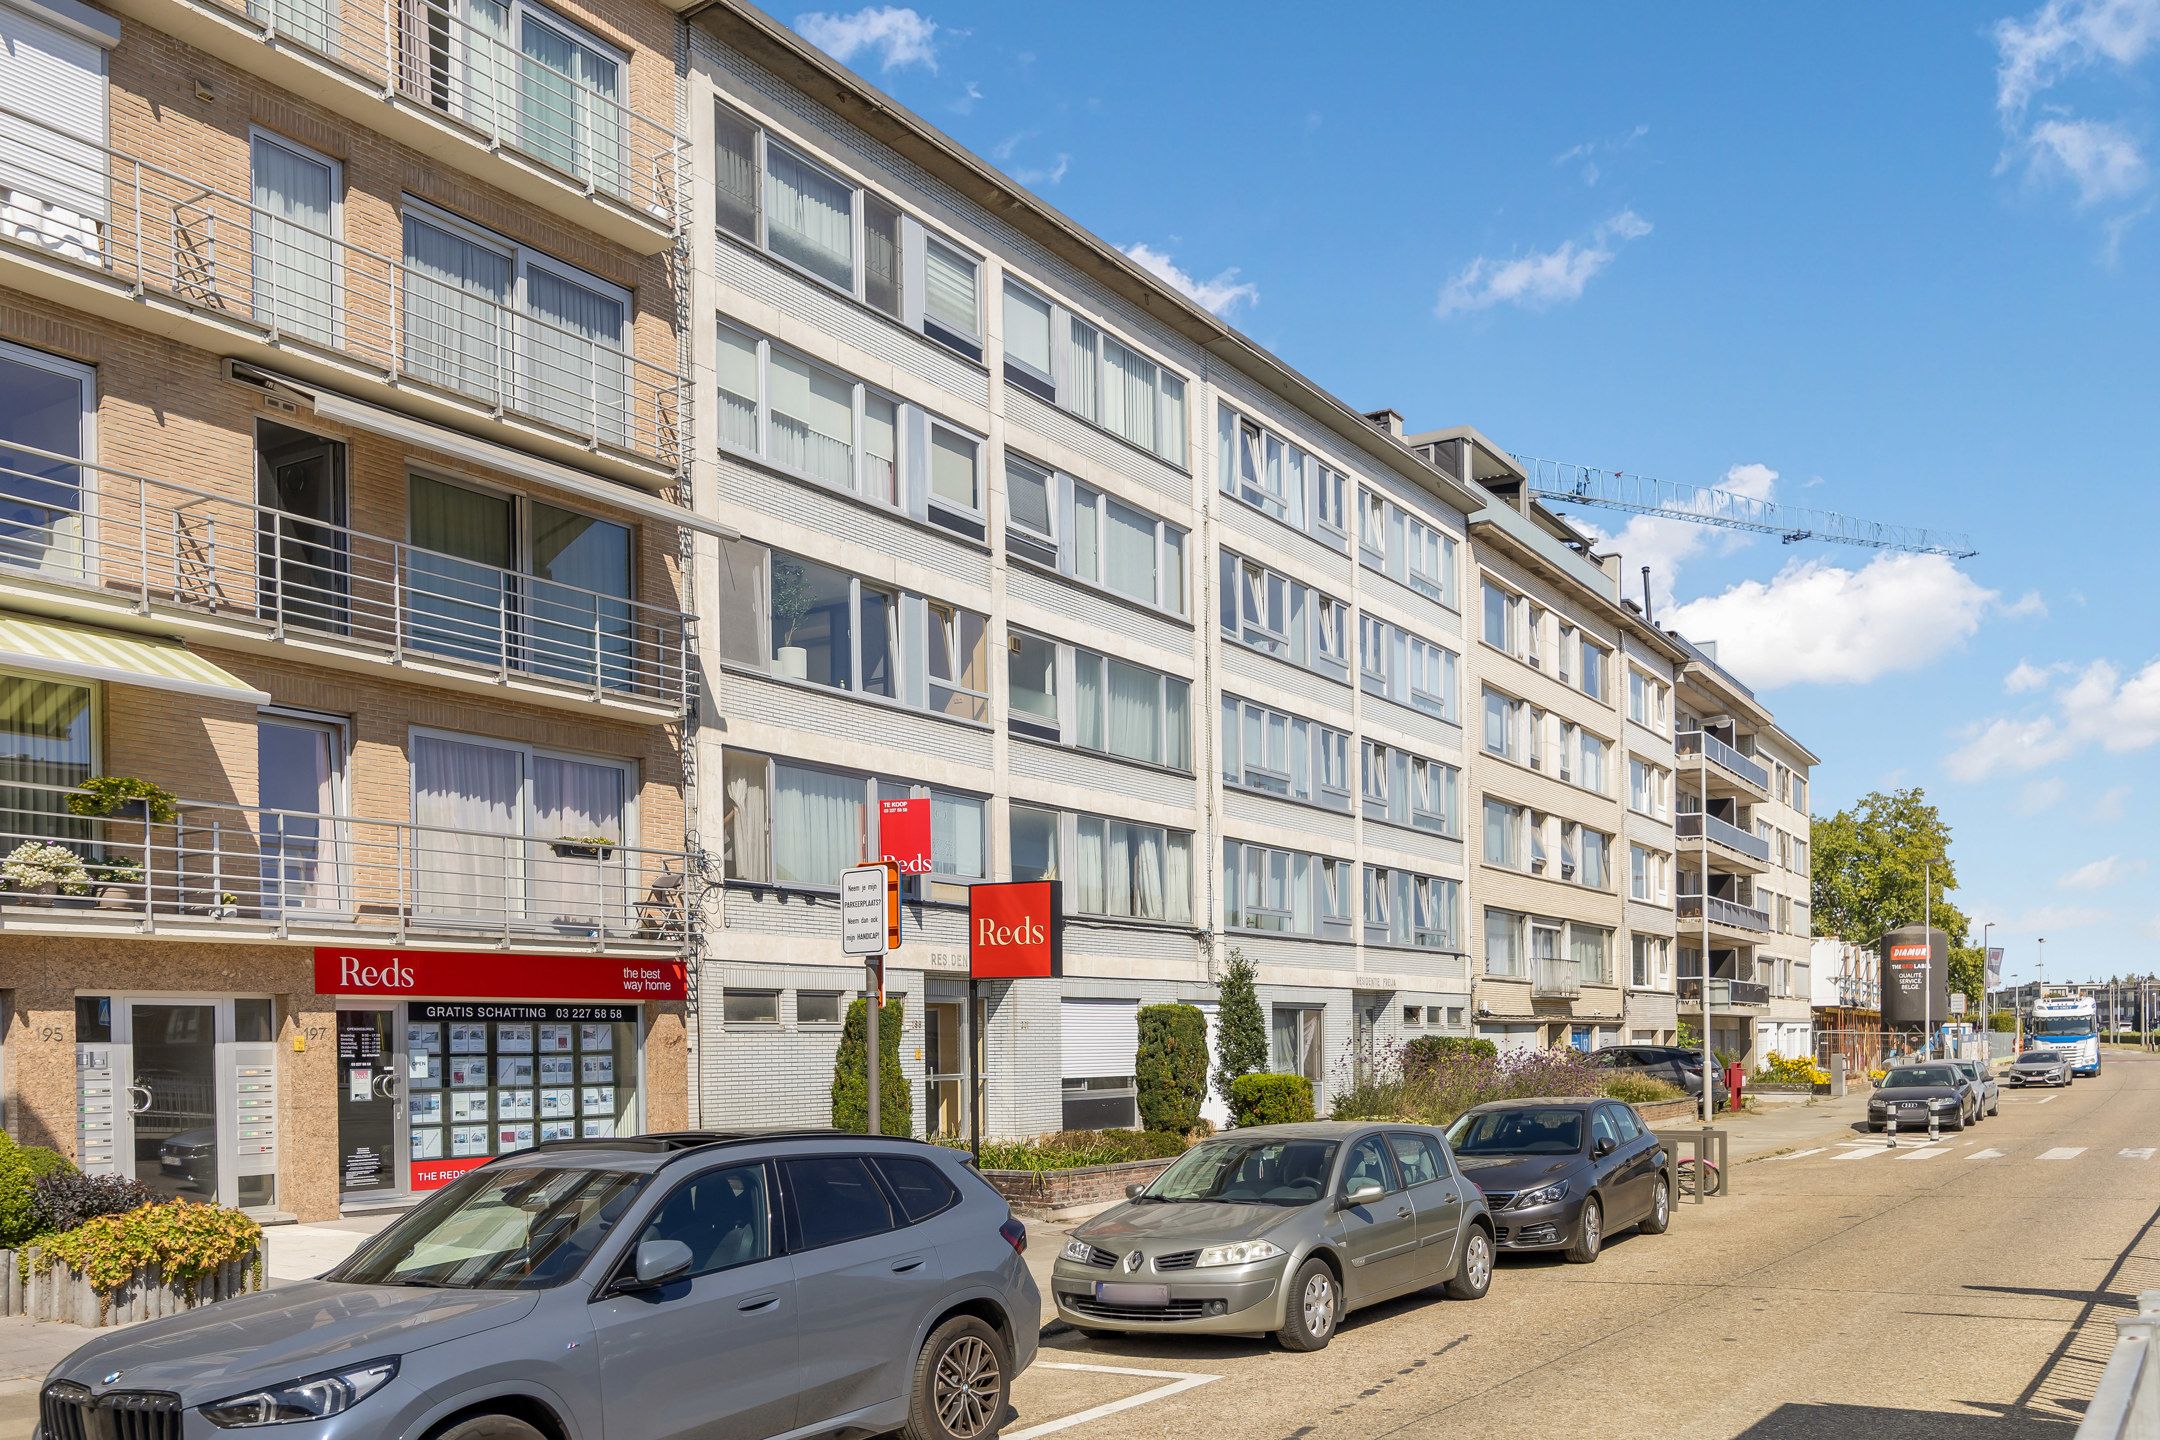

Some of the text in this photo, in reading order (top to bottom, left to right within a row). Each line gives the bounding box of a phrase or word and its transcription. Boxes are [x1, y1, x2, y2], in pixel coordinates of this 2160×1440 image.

[978, 915, 1045, 946] Reds
[339, 956, 415, 988] Reds
[623, 966, 661, 979] the best
[623, 979, 671, 993] way home
[426, 1006, 622, 1019] GRATIS SCHATTING 03 227 58 58
[36, 1027, 63, 1042] 195
[304, 1027, 327, 1040] 197
[418, 1172, 438, 1181] THE
[439, 1170, 466, 1180] REDS
